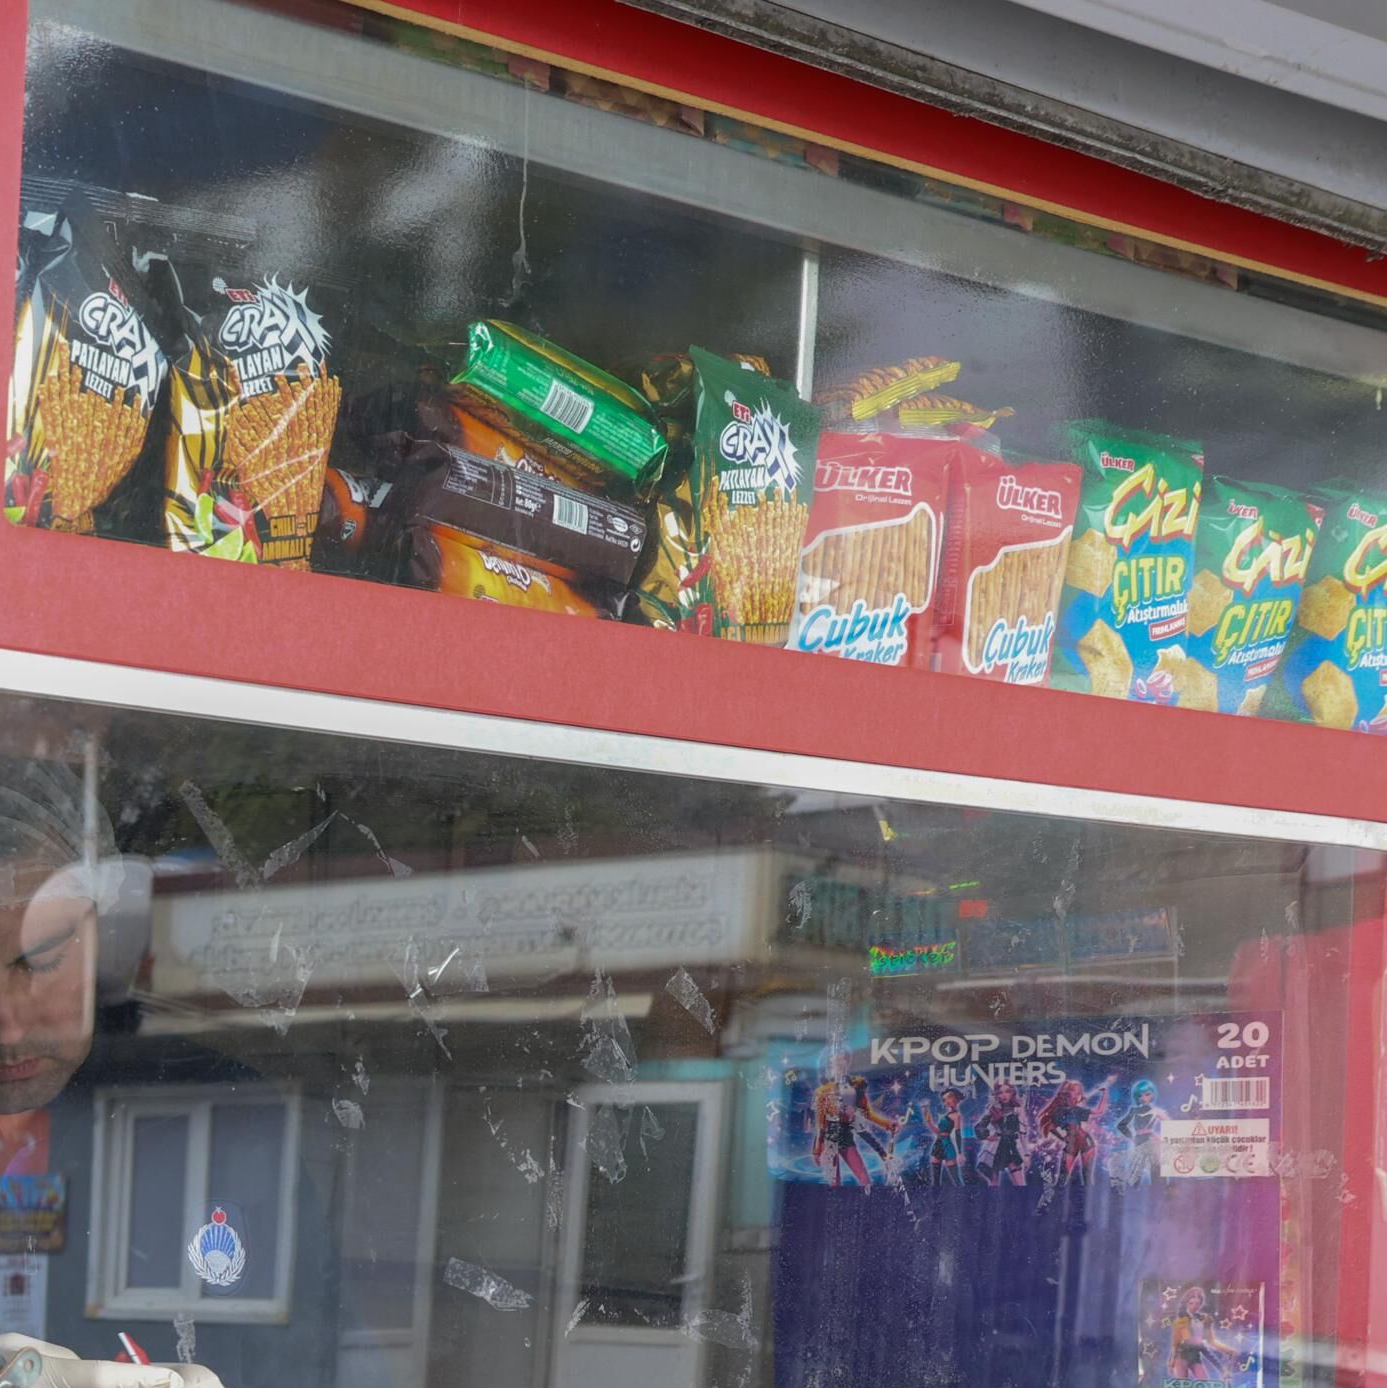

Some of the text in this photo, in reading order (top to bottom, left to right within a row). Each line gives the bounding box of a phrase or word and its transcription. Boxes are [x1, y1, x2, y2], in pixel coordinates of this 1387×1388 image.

[70, 338, 131, 387] PATLAYAN
[232, 345, 286, 382] TLAYAN
[733, 402, 751, 422] ETi
[720, 415, 797, 494] CRAX
[1100, 451, 1136, 472] ÜLKER
[731, 488, 757, 505] LEZZET
[814, 458, 913, 497] ÜLKER
[996, 475, 1063, 519] ÜLKER
[1103, 464, 1203, 551] Çizi
[1113, 556, 1186, 626] ÇITIR
[984, 612, 1055, 671] Çubuk
[1011, 1022, 1150, 1061] DEMON
[1216, 1021, 1270, 1049] 20
[928, 1060, 1068, 1092] HUNTERS
[1215, 1054, 1270, 1070] ADET
